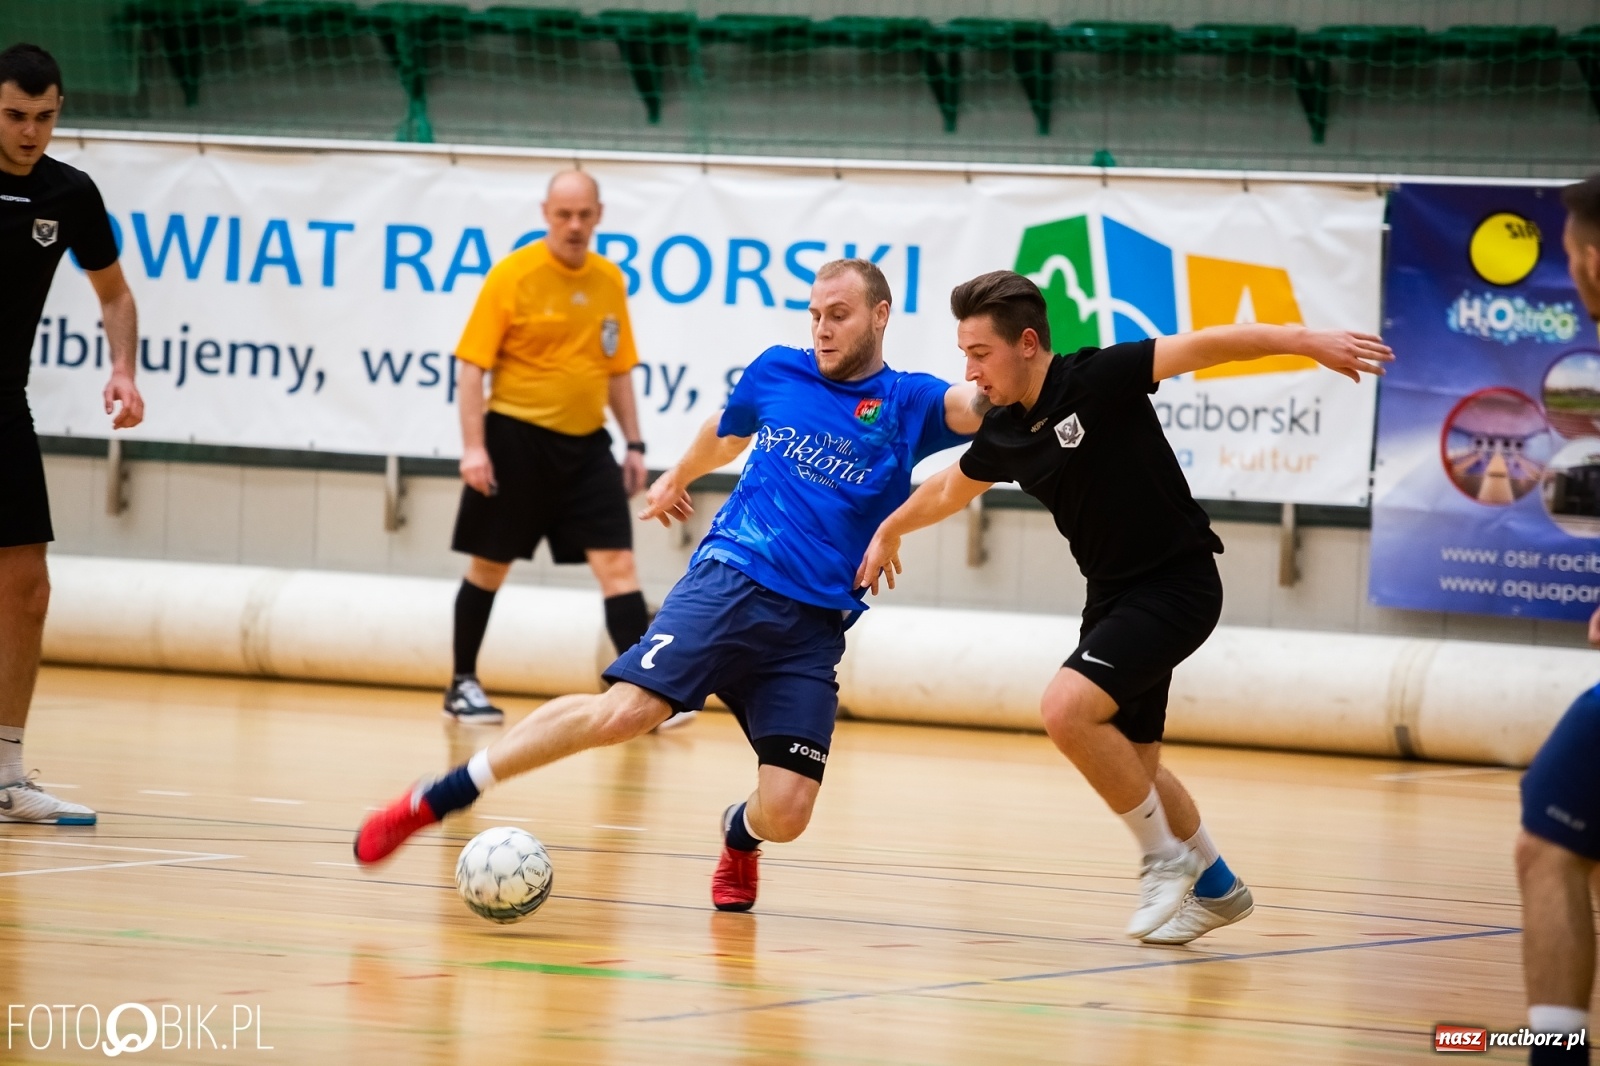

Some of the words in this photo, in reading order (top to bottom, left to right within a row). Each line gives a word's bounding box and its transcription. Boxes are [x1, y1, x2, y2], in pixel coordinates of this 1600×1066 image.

[69, 212, 355, 287] WIAT
[383, 224, 920, 313] RABORSI
[31, 317, 326, 393] ibiujemy,
[640, 633, 675, 670] 7
